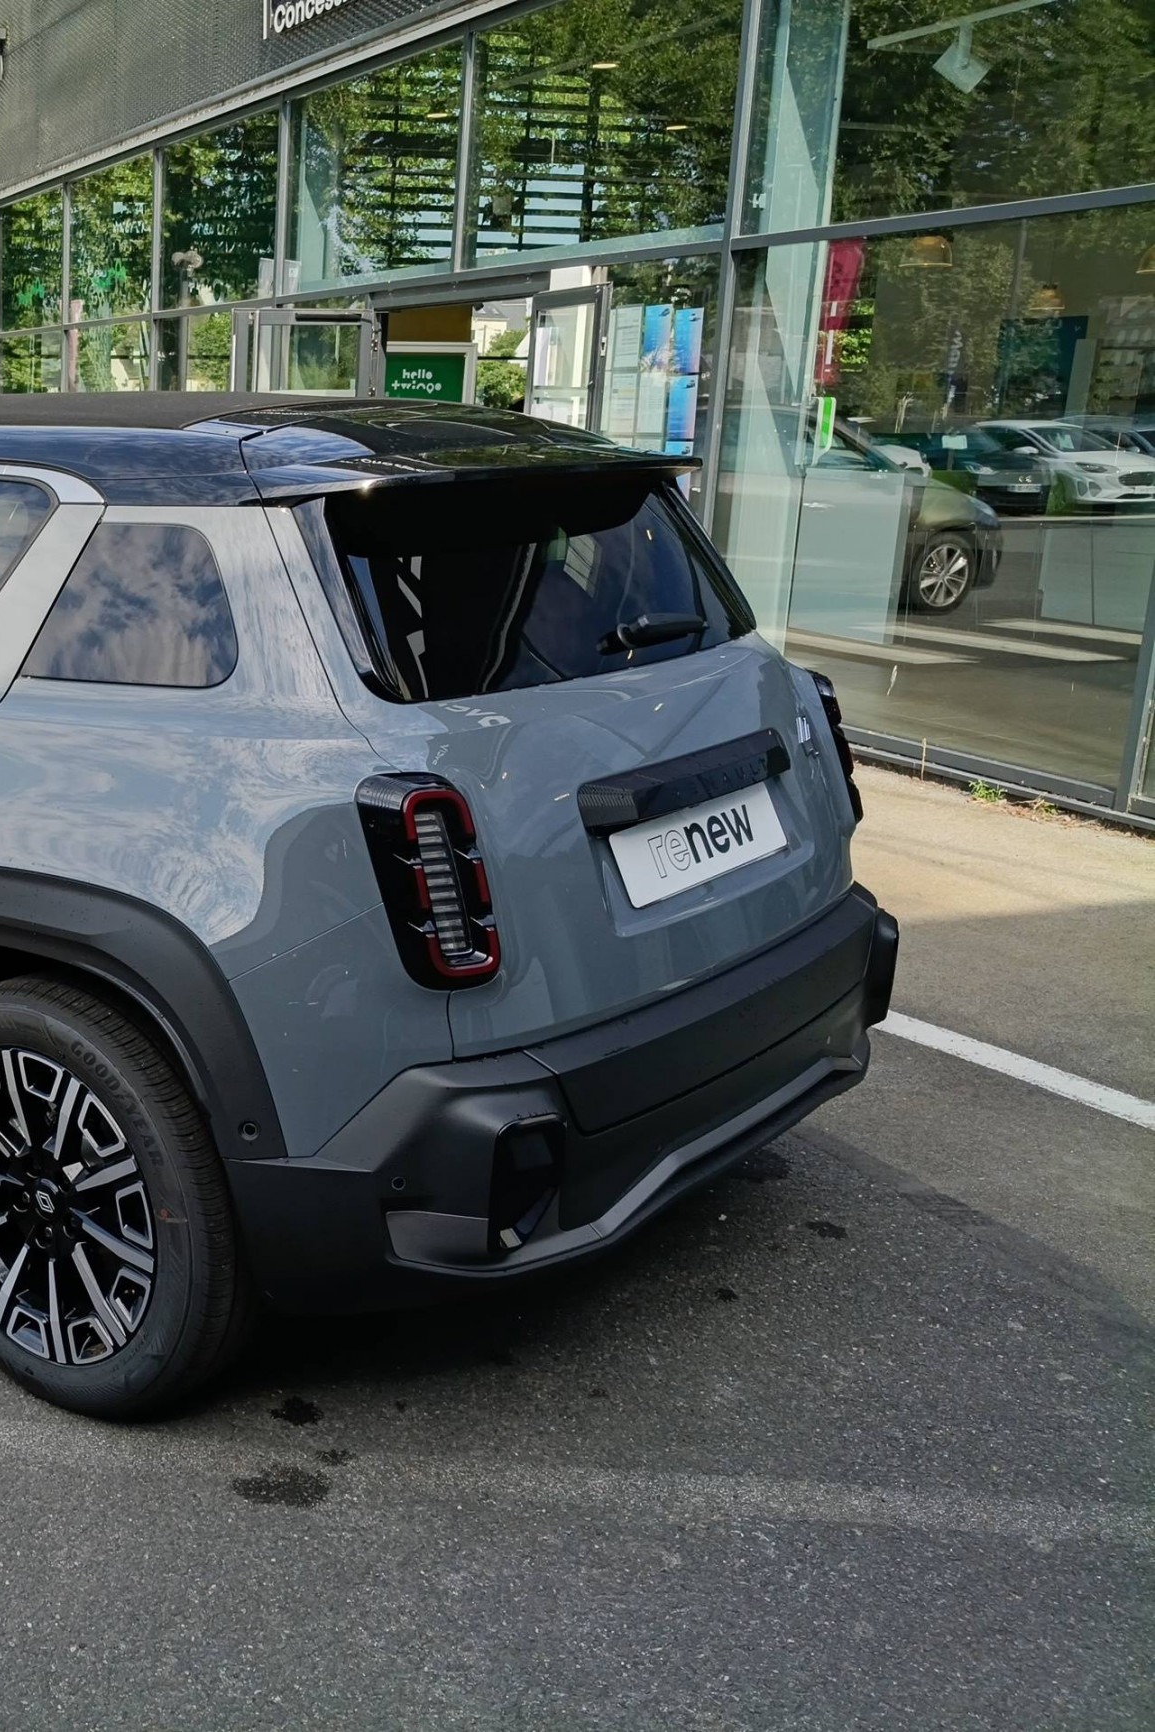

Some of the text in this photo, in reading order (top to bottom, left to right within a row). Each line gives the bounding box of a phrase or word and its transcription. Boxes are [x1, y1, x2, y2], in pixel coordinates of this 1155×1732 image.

[273, 0, 347, 33] Conces
[402, 368, 433, 380] hello
[647, 804, 754, 879] renew
